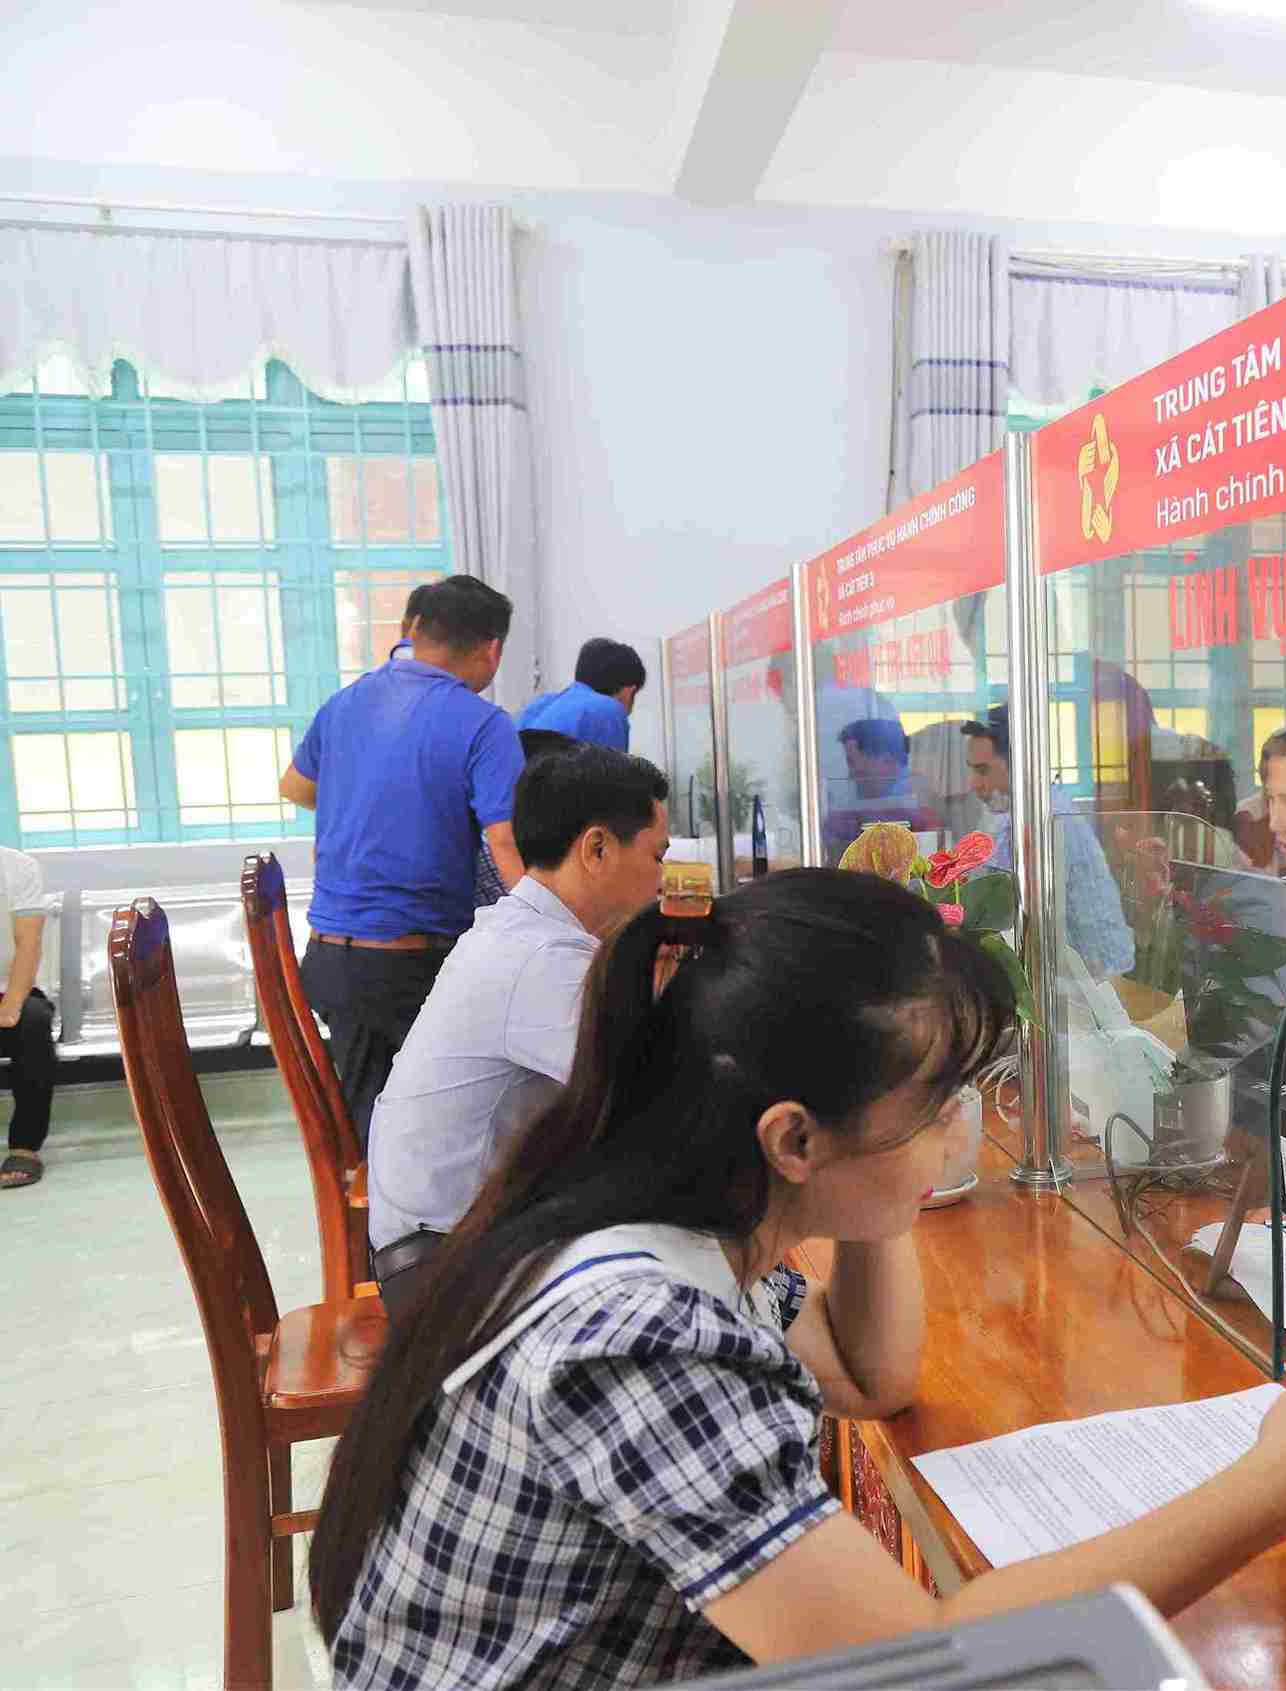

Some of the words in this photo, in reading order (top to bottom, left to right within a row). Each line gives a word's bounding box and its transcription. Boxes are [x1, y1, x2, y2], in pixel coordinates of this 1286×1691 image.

[1153, 366, 1226, 423] TRUNG
[1231, 337, 1281, 388] TÂM
[1155, 436, 1181, 476] XÃ
[1187, 421, 1228, 464] CÁT
[1156, 489, 1208, 528] Hành
[1216, 464, 1284, 511] chính
